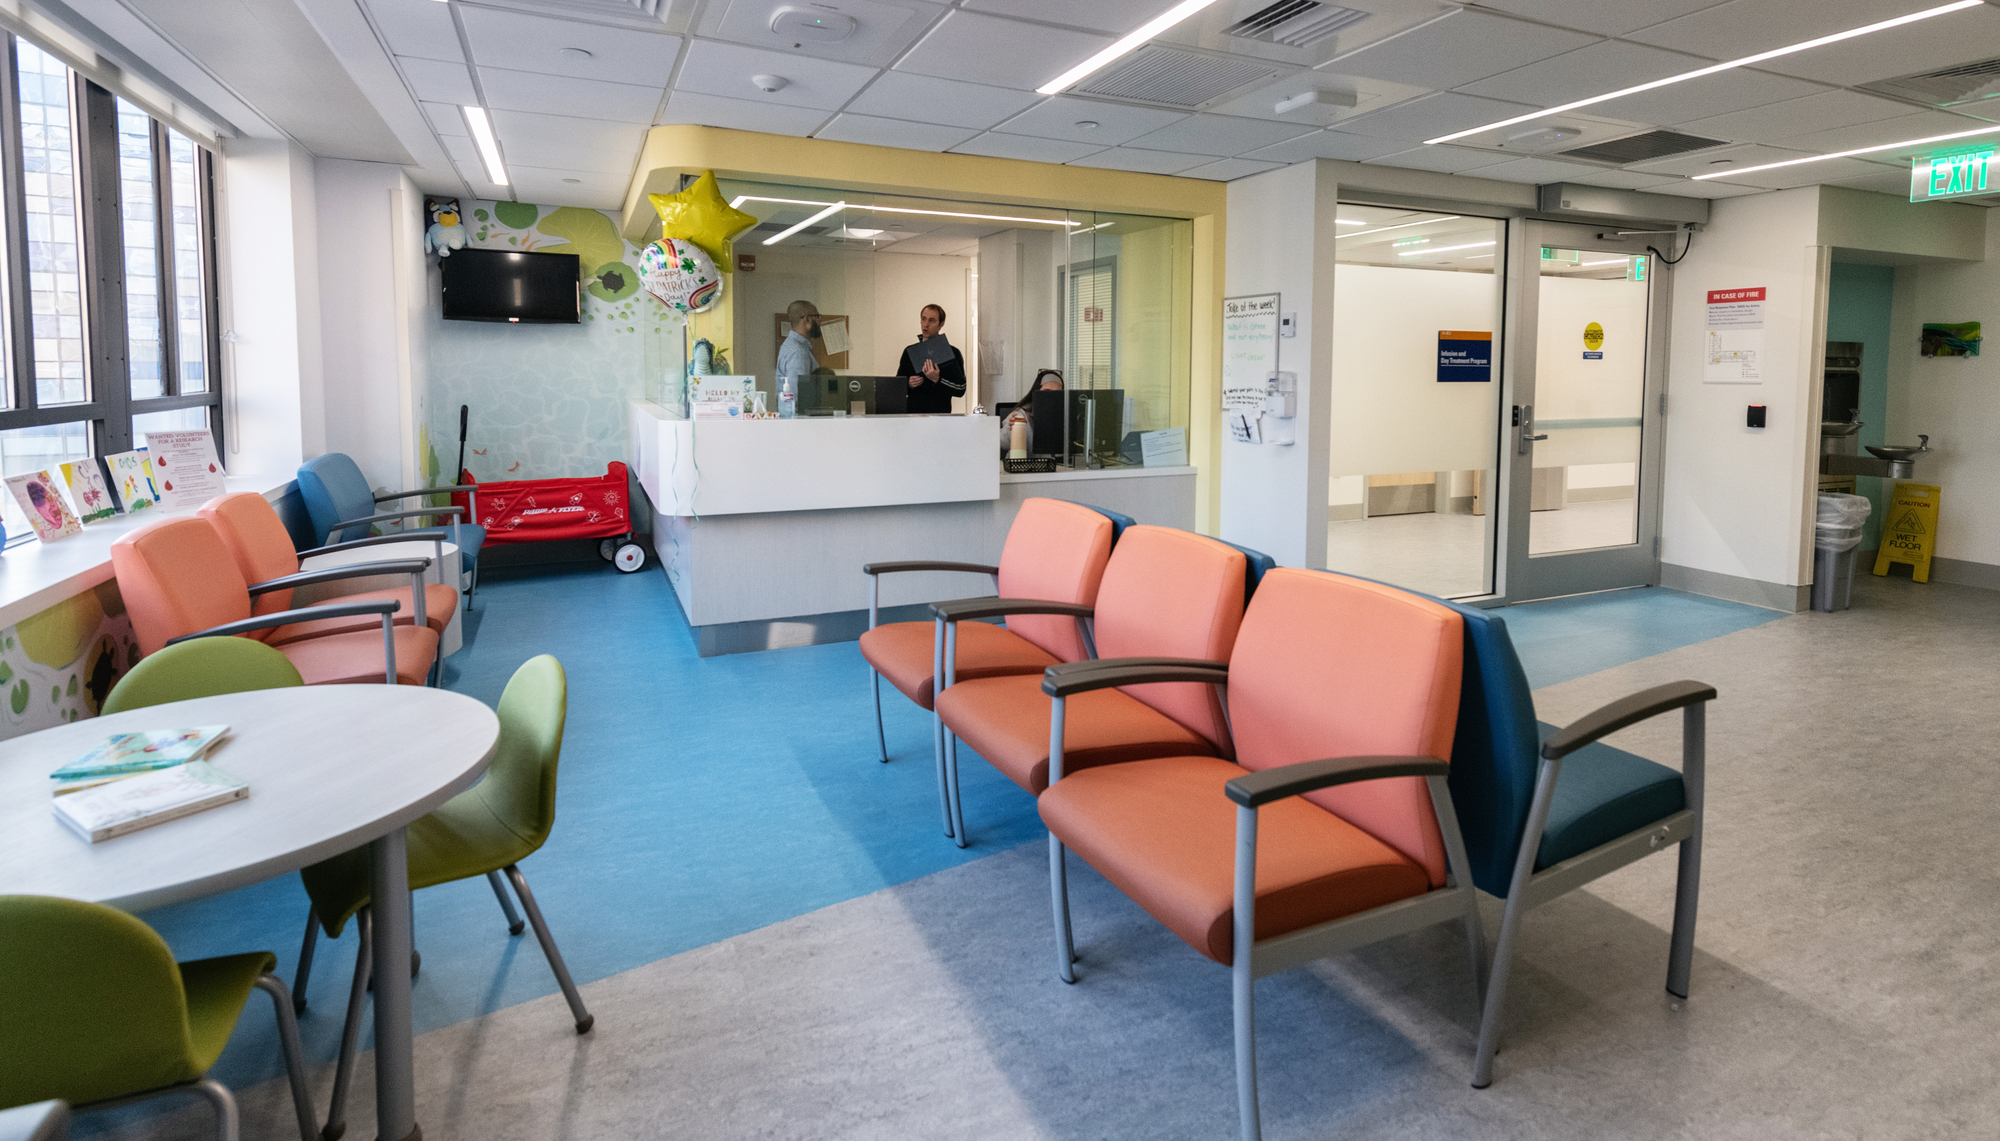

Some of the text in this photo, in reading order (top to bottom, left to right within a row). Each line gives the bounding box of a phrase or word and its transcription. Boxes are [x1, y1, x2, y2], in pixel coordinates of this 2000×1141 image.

[1928, 150, 1994, 197] EXIT
[650, 267, 681, 281] Happy
[1241, 301, 1246, 311] of
[1249, 301, 1258, 310] the
[1898, 500, 1931, 508] CAUTION
[1896, 533, 1918, 543] WET
[1889, 540, 1921, 551] FLOOR
